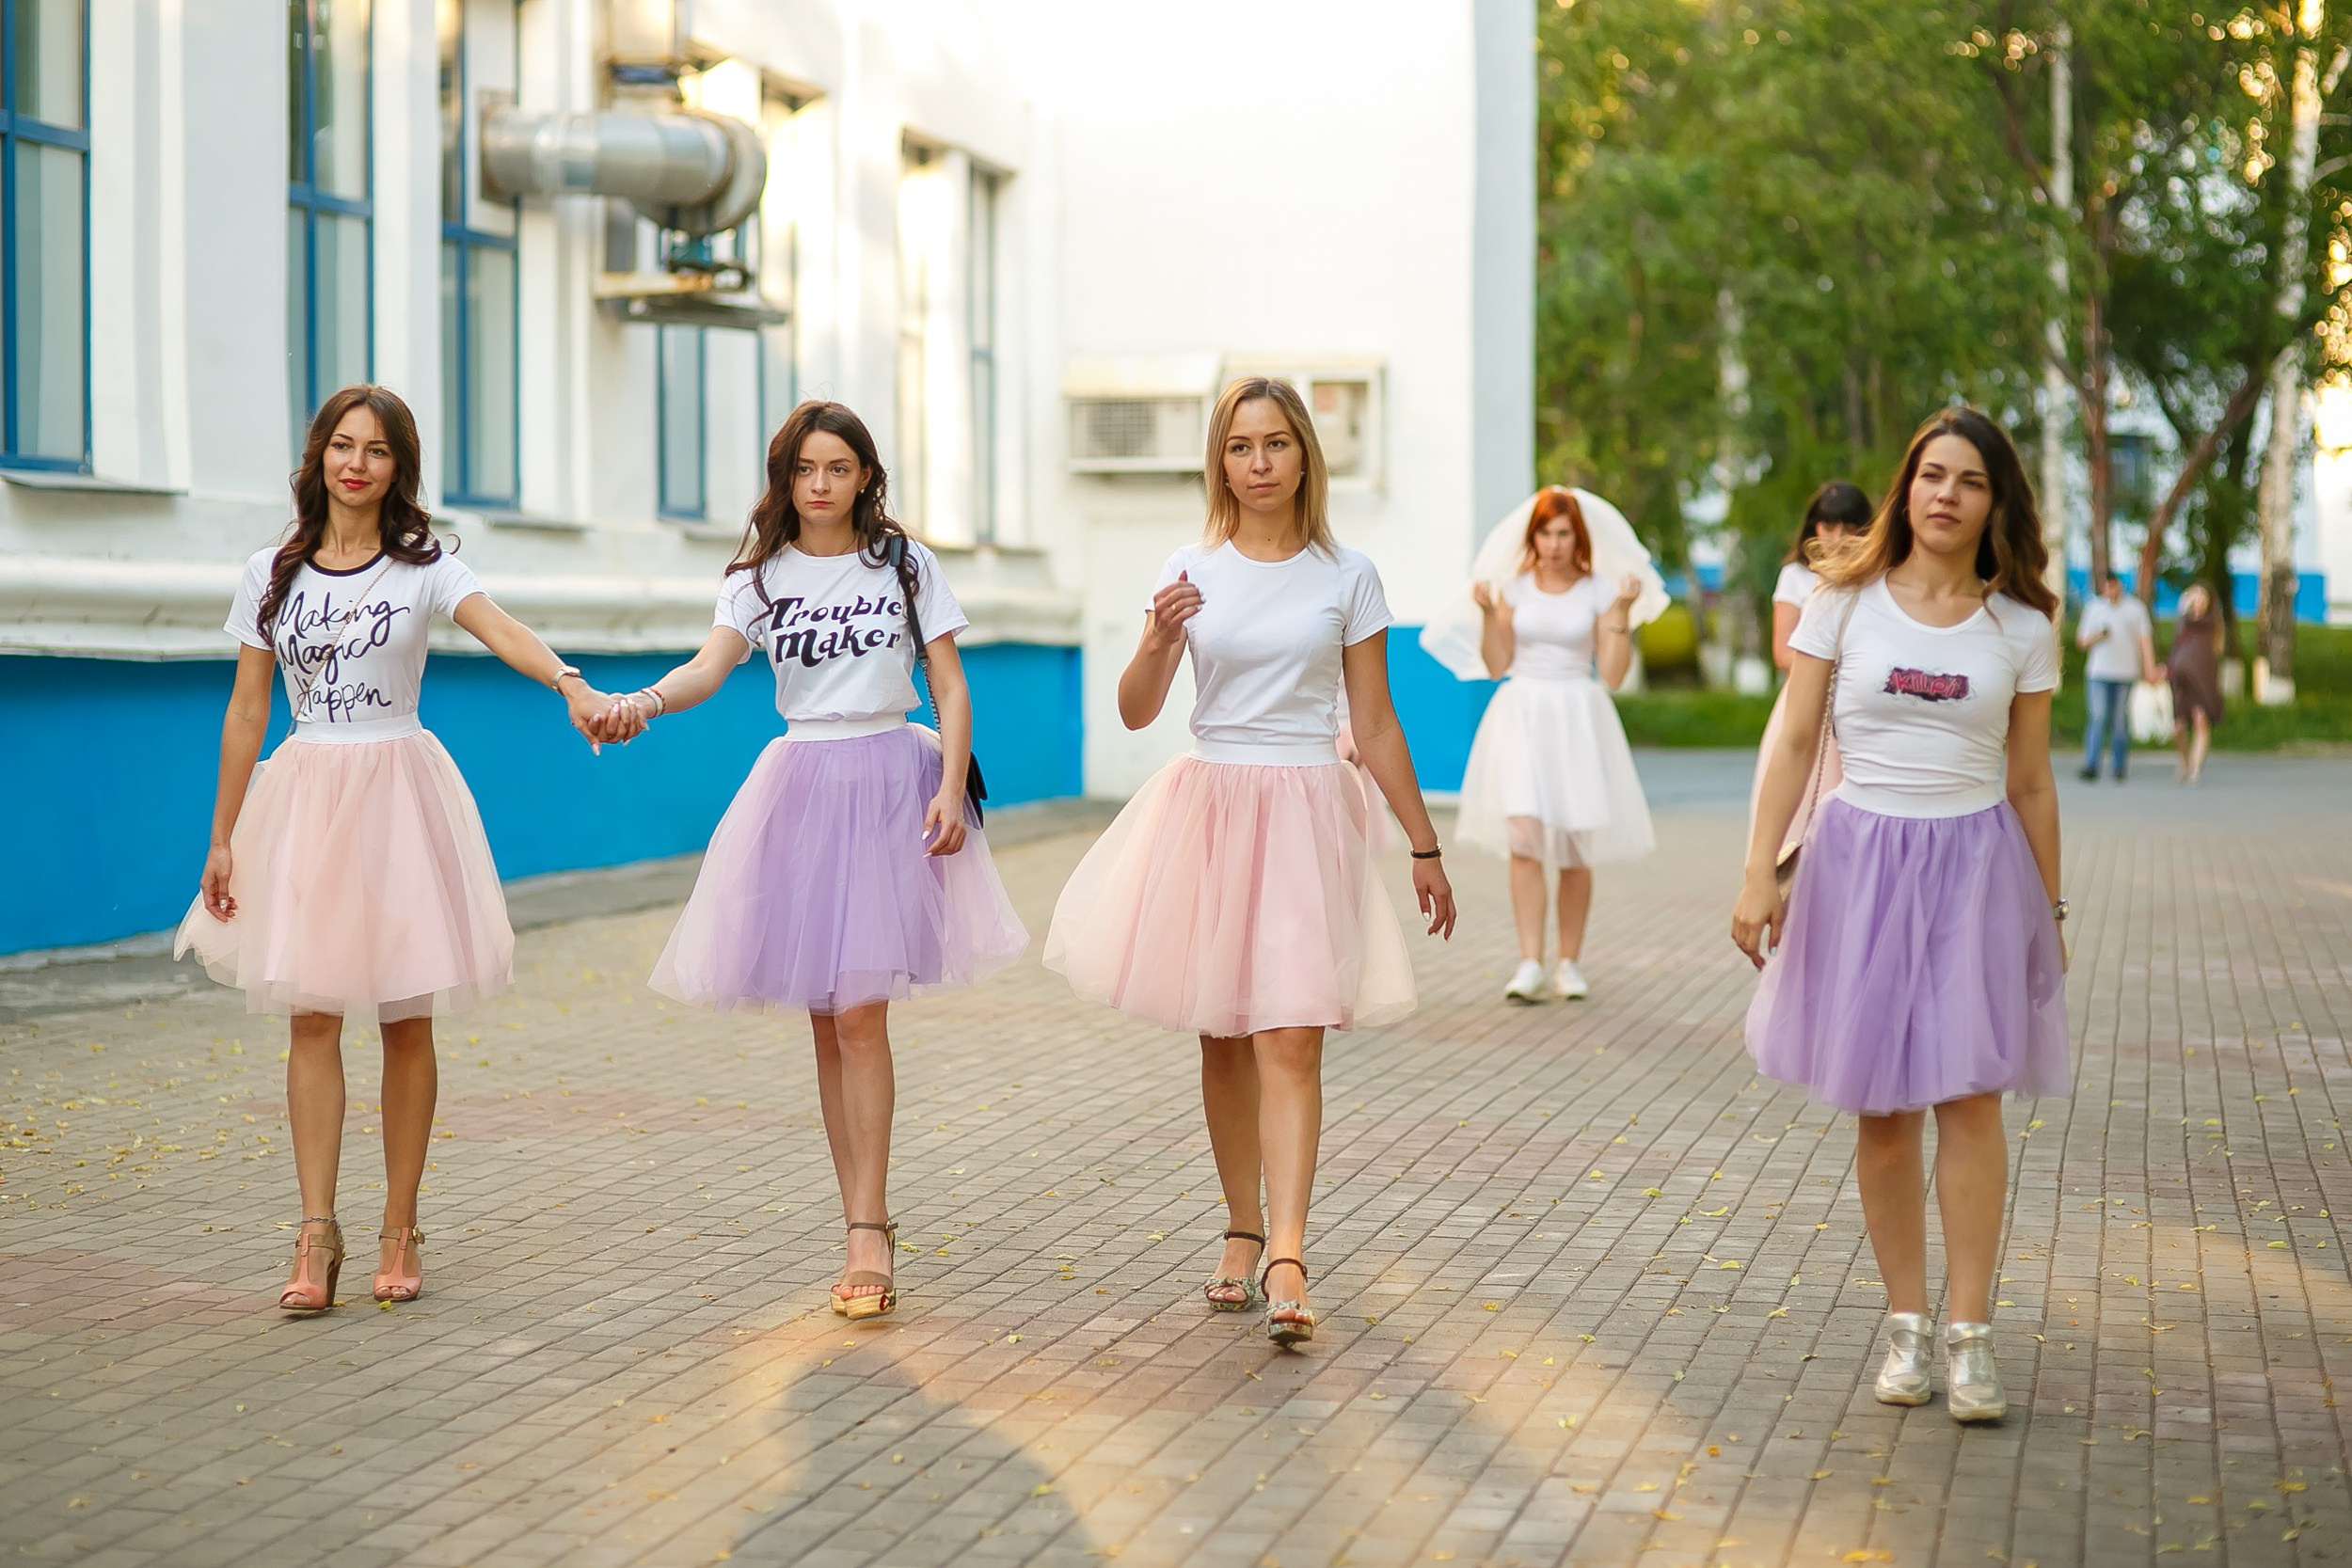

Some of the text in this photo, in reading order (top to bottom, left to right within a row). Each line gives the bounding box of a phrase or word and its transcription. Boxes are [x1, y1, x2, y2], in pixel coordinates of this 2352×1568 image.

[273, 591, 410, 647] Making
[770, 595, 902, 632] Trouble
[278, 634, 373, 686] Magic
[294, 673, 392, 723] Happen
